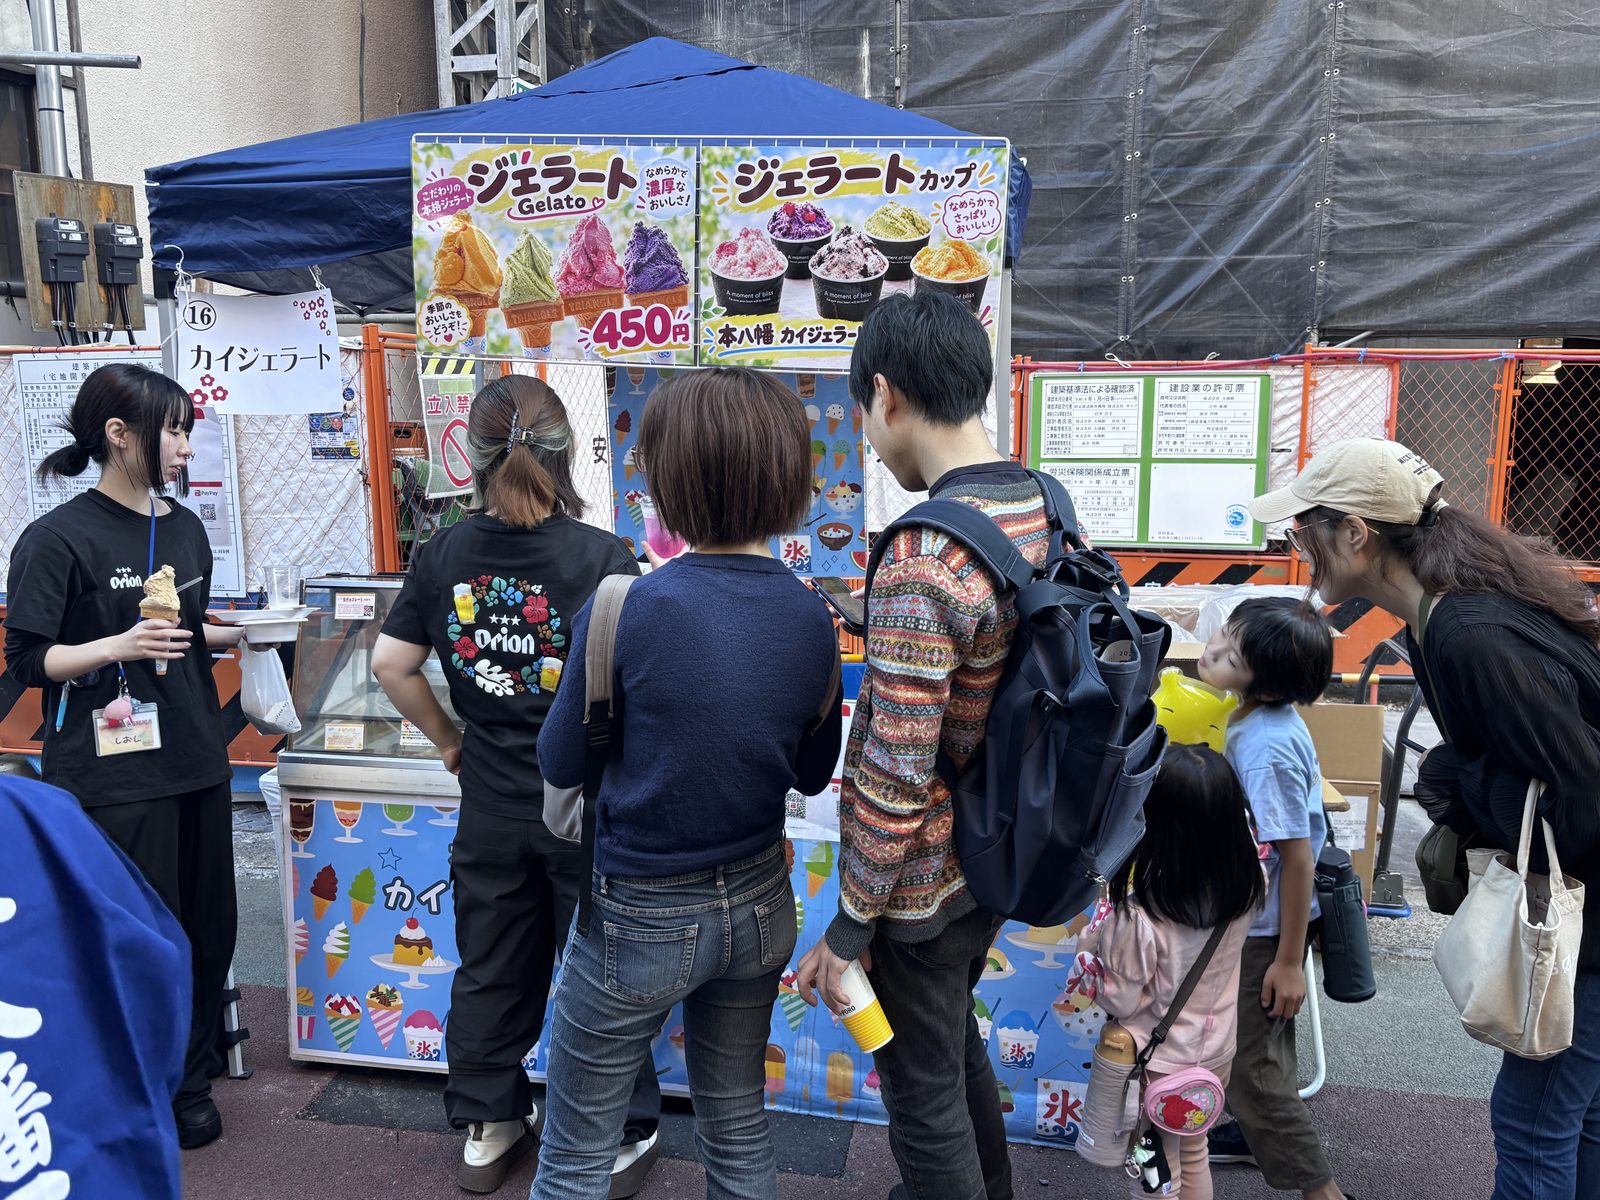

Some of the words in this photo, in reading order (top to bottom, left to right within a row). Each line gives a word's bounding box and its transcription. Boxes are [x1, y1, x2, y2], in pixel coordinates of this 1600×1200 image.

[468, 156, 638, 204] ジェラート
[646, 165, 689, 179] なめらかで
[735, 153, 915, 204] ジェラート
[919, 162, 977, 191] カップ
[422, 183, 462, 202] こだわりの
[645, 177, 687, 198] 濃厚な
[421, 193, 472, 217] 本格ジェラート
[518, 195, 586, 216] Gelato
[948, 198, 995, 212] なめらかで
[954, 208, 987, 223] さっぱり
[732, 291, 754, 299] moment
[829, 291, 852, 299] moment
[425, 309, 462, 326] おいしさを
[427, 301, 452, 315] 季節の
[593, 305, 690, 350] 450円
[718, 323, 775, 348] 本八幡
[190, 344, 331, 372] カイジェラート
[1050, 384, 1135, 394] 建築基準法による確認済
[1169, 383, 1245, 393] 建設業の許可票
[427, 394, 470, 415] 立入禁
[1049, 467, 1130, 477] 労災保険関係成立票
[784, 540, 805, 561] 氷
[1042, 1089, 1083, 1127] 氷
